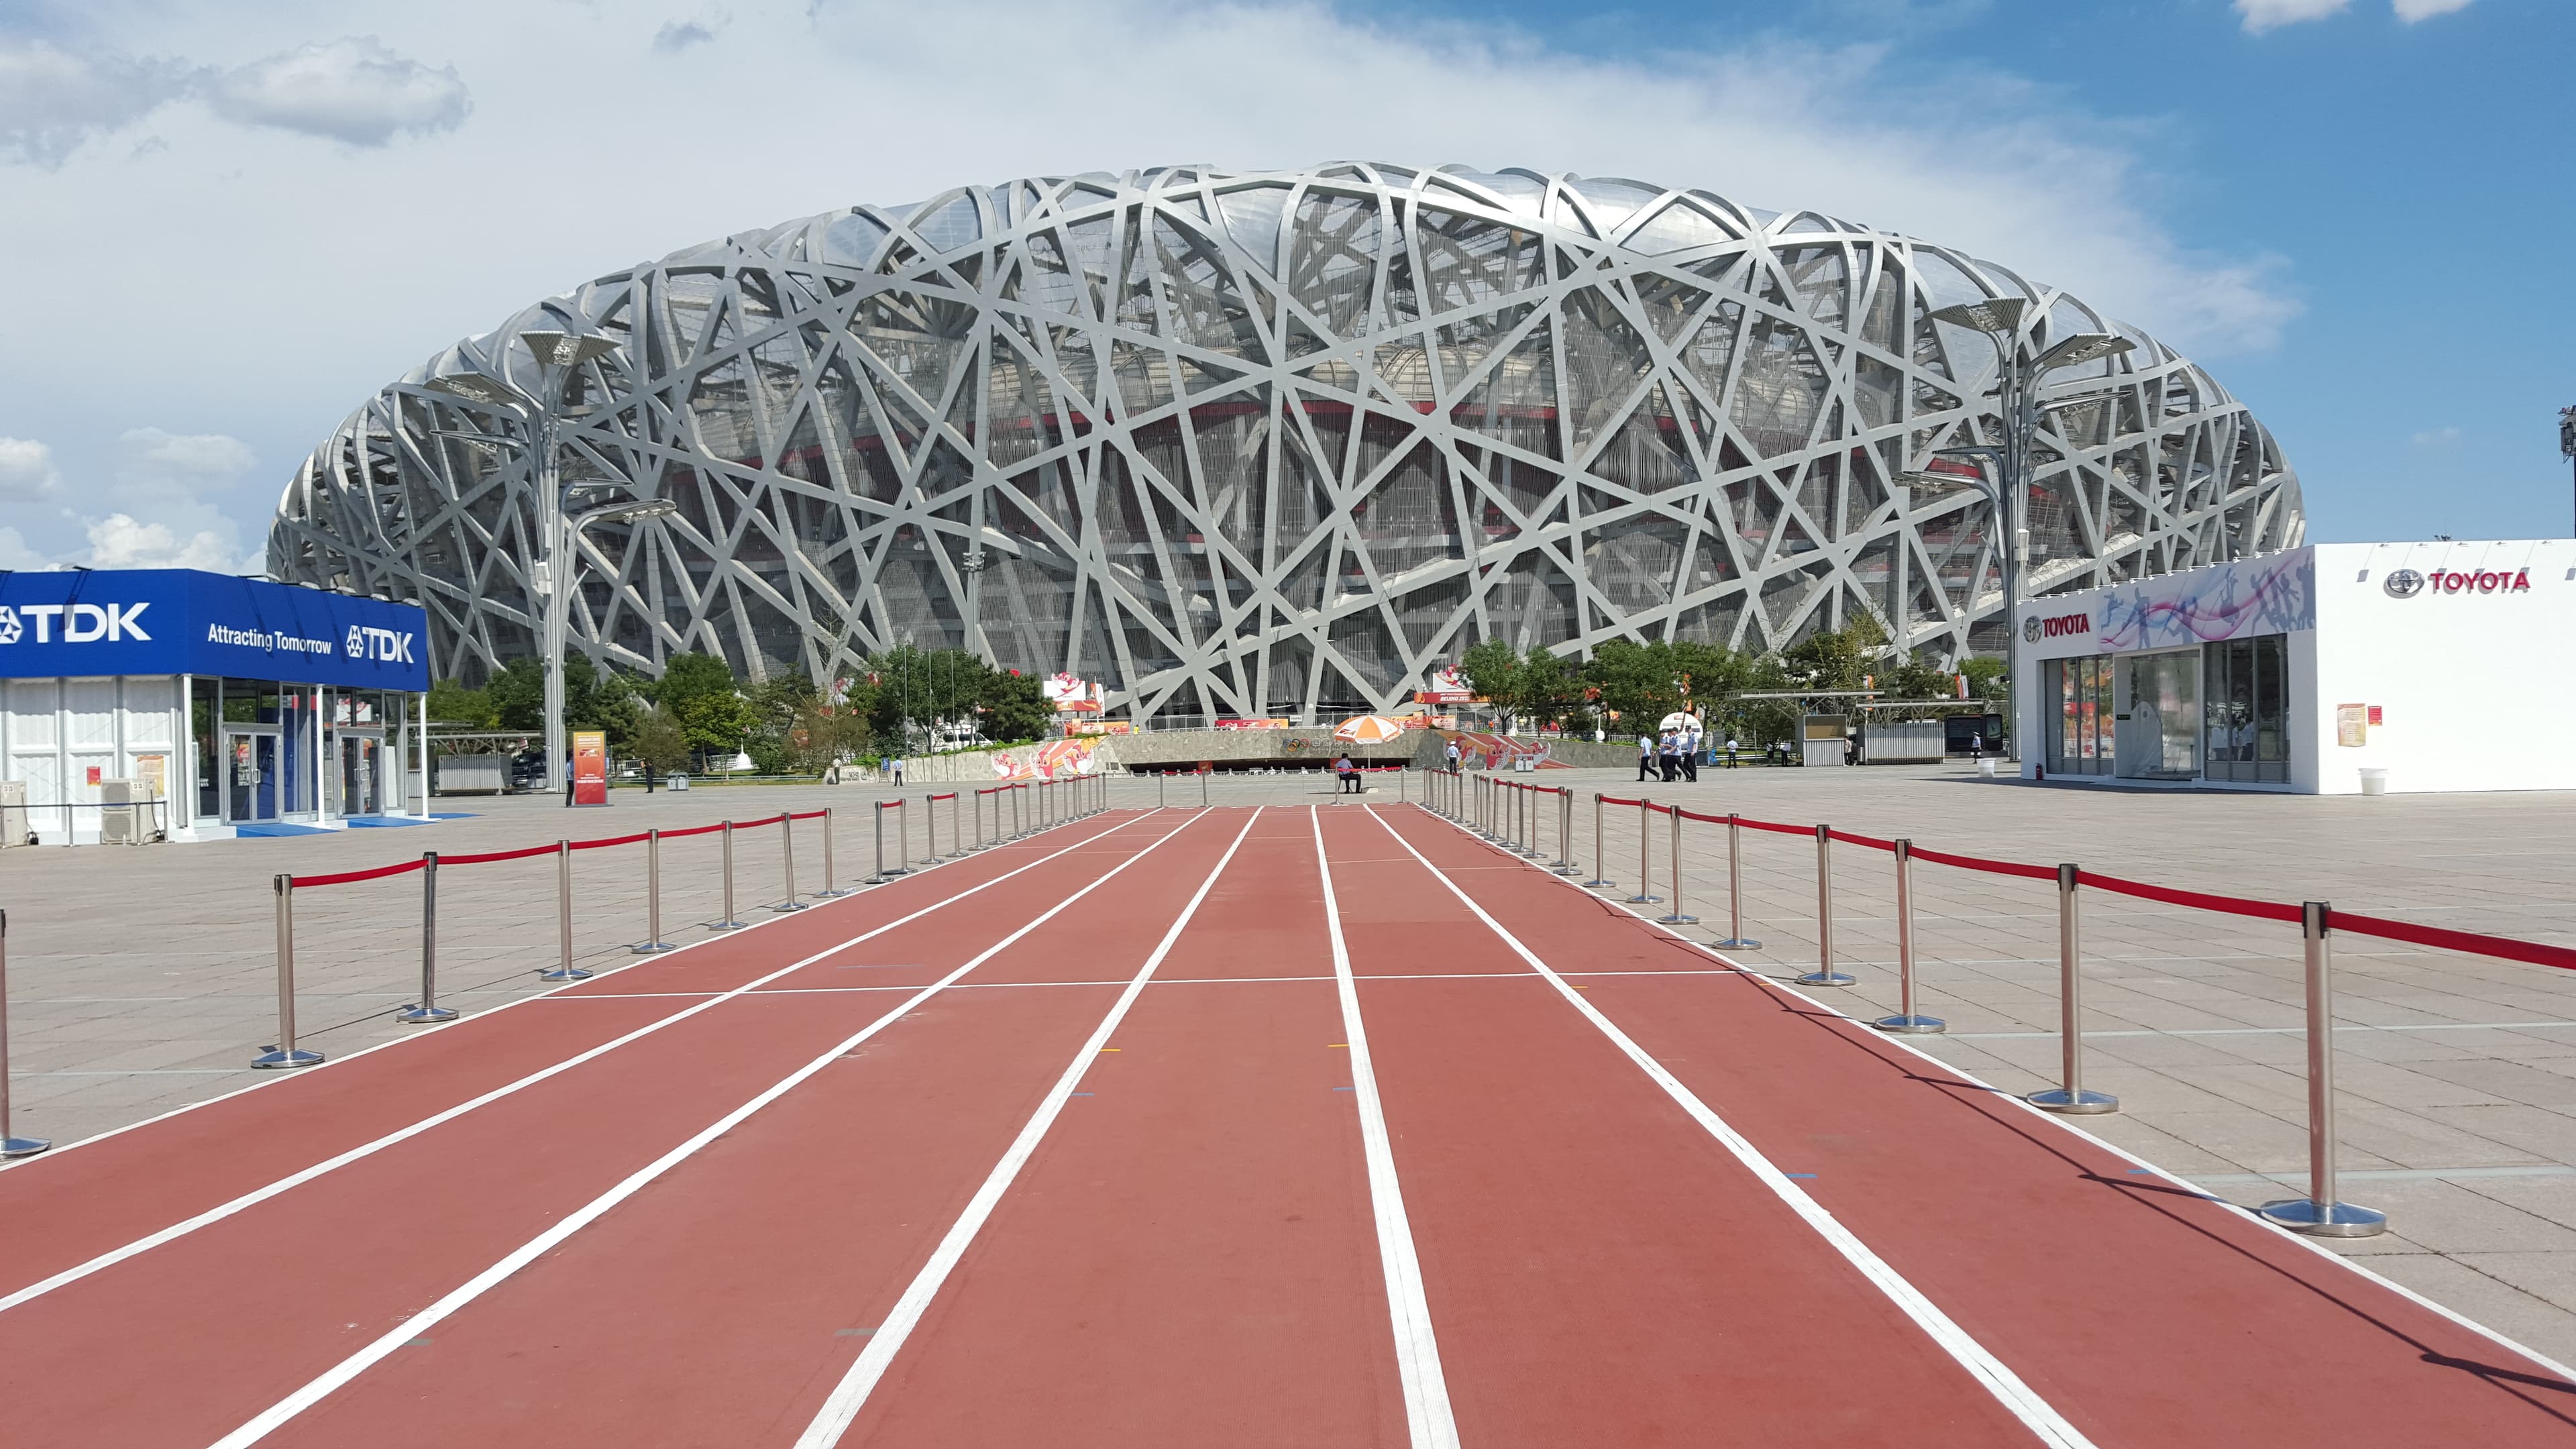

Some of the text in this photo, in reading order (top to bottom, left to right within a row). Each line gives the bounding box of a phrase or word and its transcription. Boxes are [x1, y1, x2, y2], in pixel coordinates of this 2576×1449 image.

[2429, 572, 2531, 590] TOYOTA
[19, 602, 153, 643] TDK
[2042, 613, 2090, 638] TOYOTA
[207, 623, 332, 655] Attracting Tomorrow
[362, 627, 414, 664] TDK
